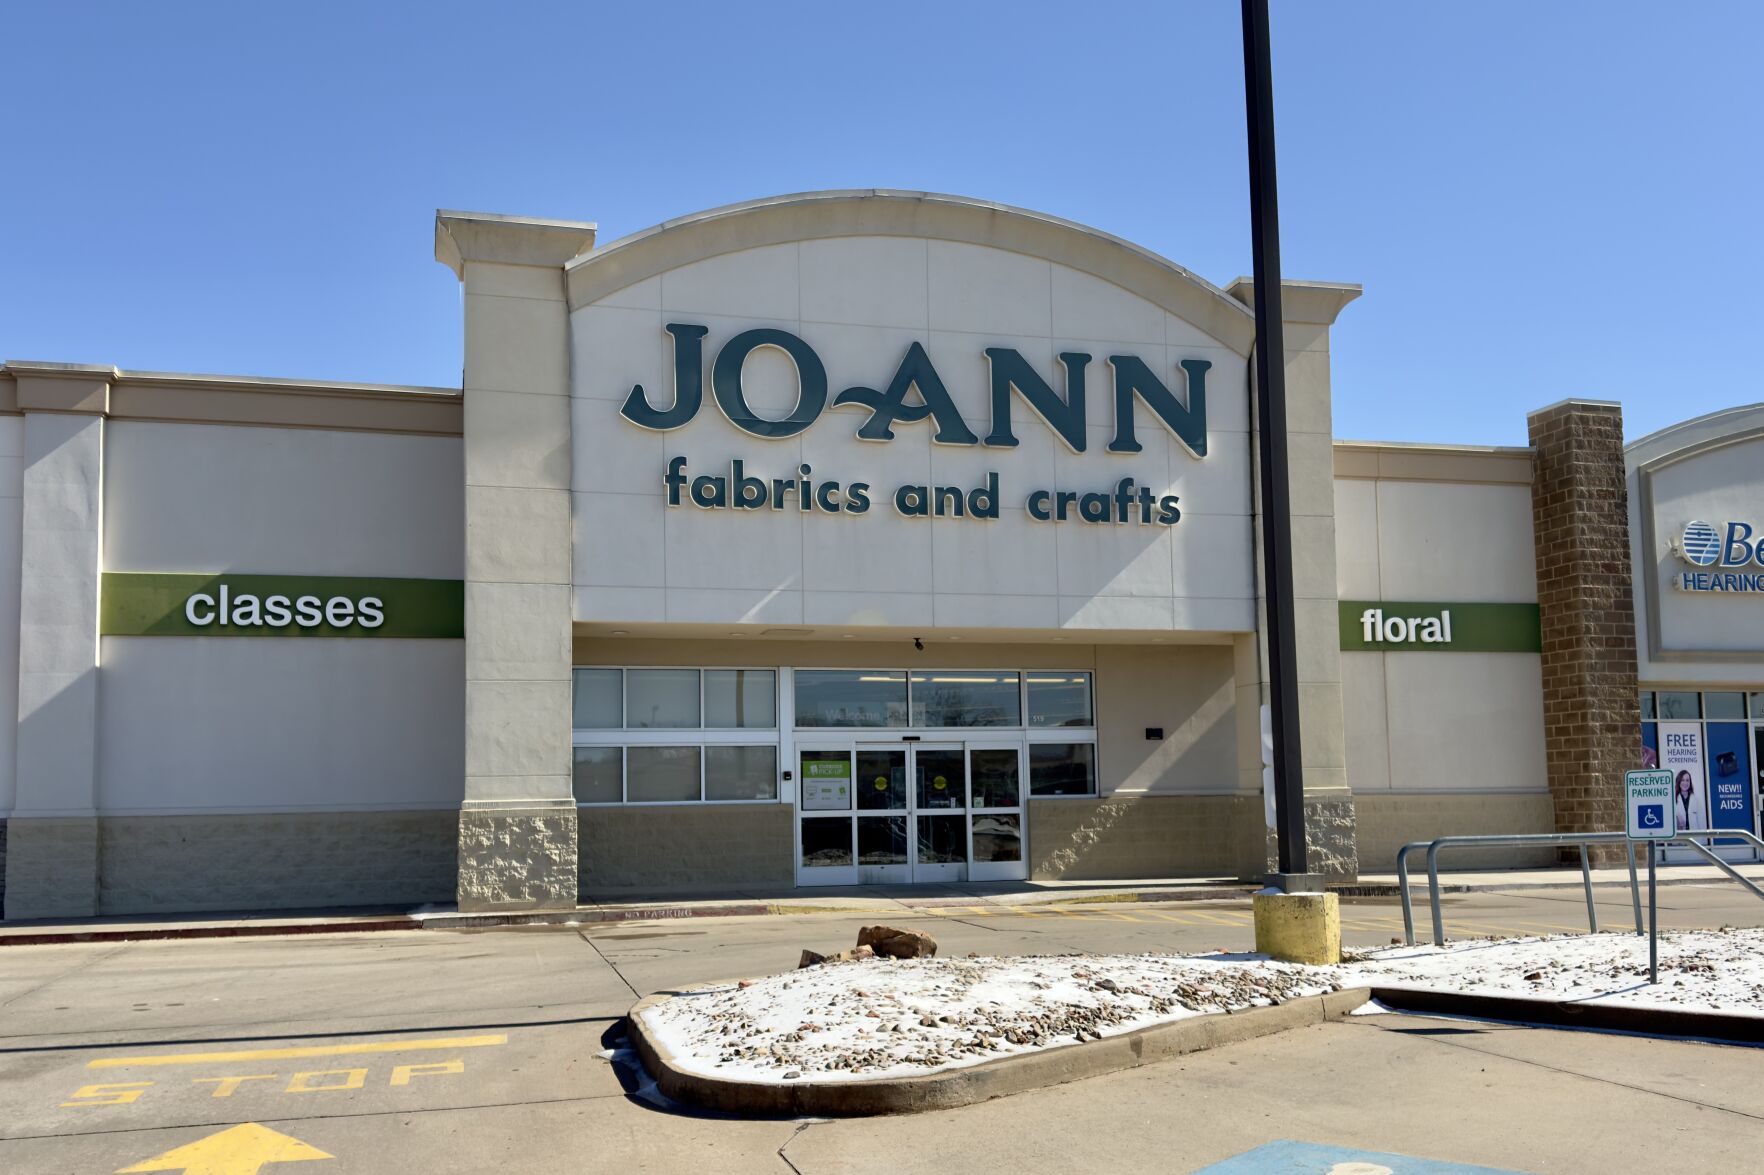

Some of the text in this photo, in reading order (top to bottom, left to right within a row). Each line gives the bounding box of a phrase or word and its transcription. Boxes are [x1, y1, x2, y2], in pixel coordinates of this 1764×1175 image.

[664, 456, 1182, 526] fabrics and crafts
[185, 584, 385, 628] classes
[1360, 608, 1452, 643] floral
[1666, 733, 1697, 748] FREE
[1667, 748, 1697, 756] HEARING
[1667, 756, 1698, 764] SCREENING
[1628, 775, 1671, 787] RESERVED
[1631, 787, 1669, 799] PARKING
[1718, 784, 1742, 793] NEW!!
[1720, 799, 1744, 810] AIDS
[624, 908, 693, 920] NO PARKING
[58, 1059, 465, 1108] STOP
